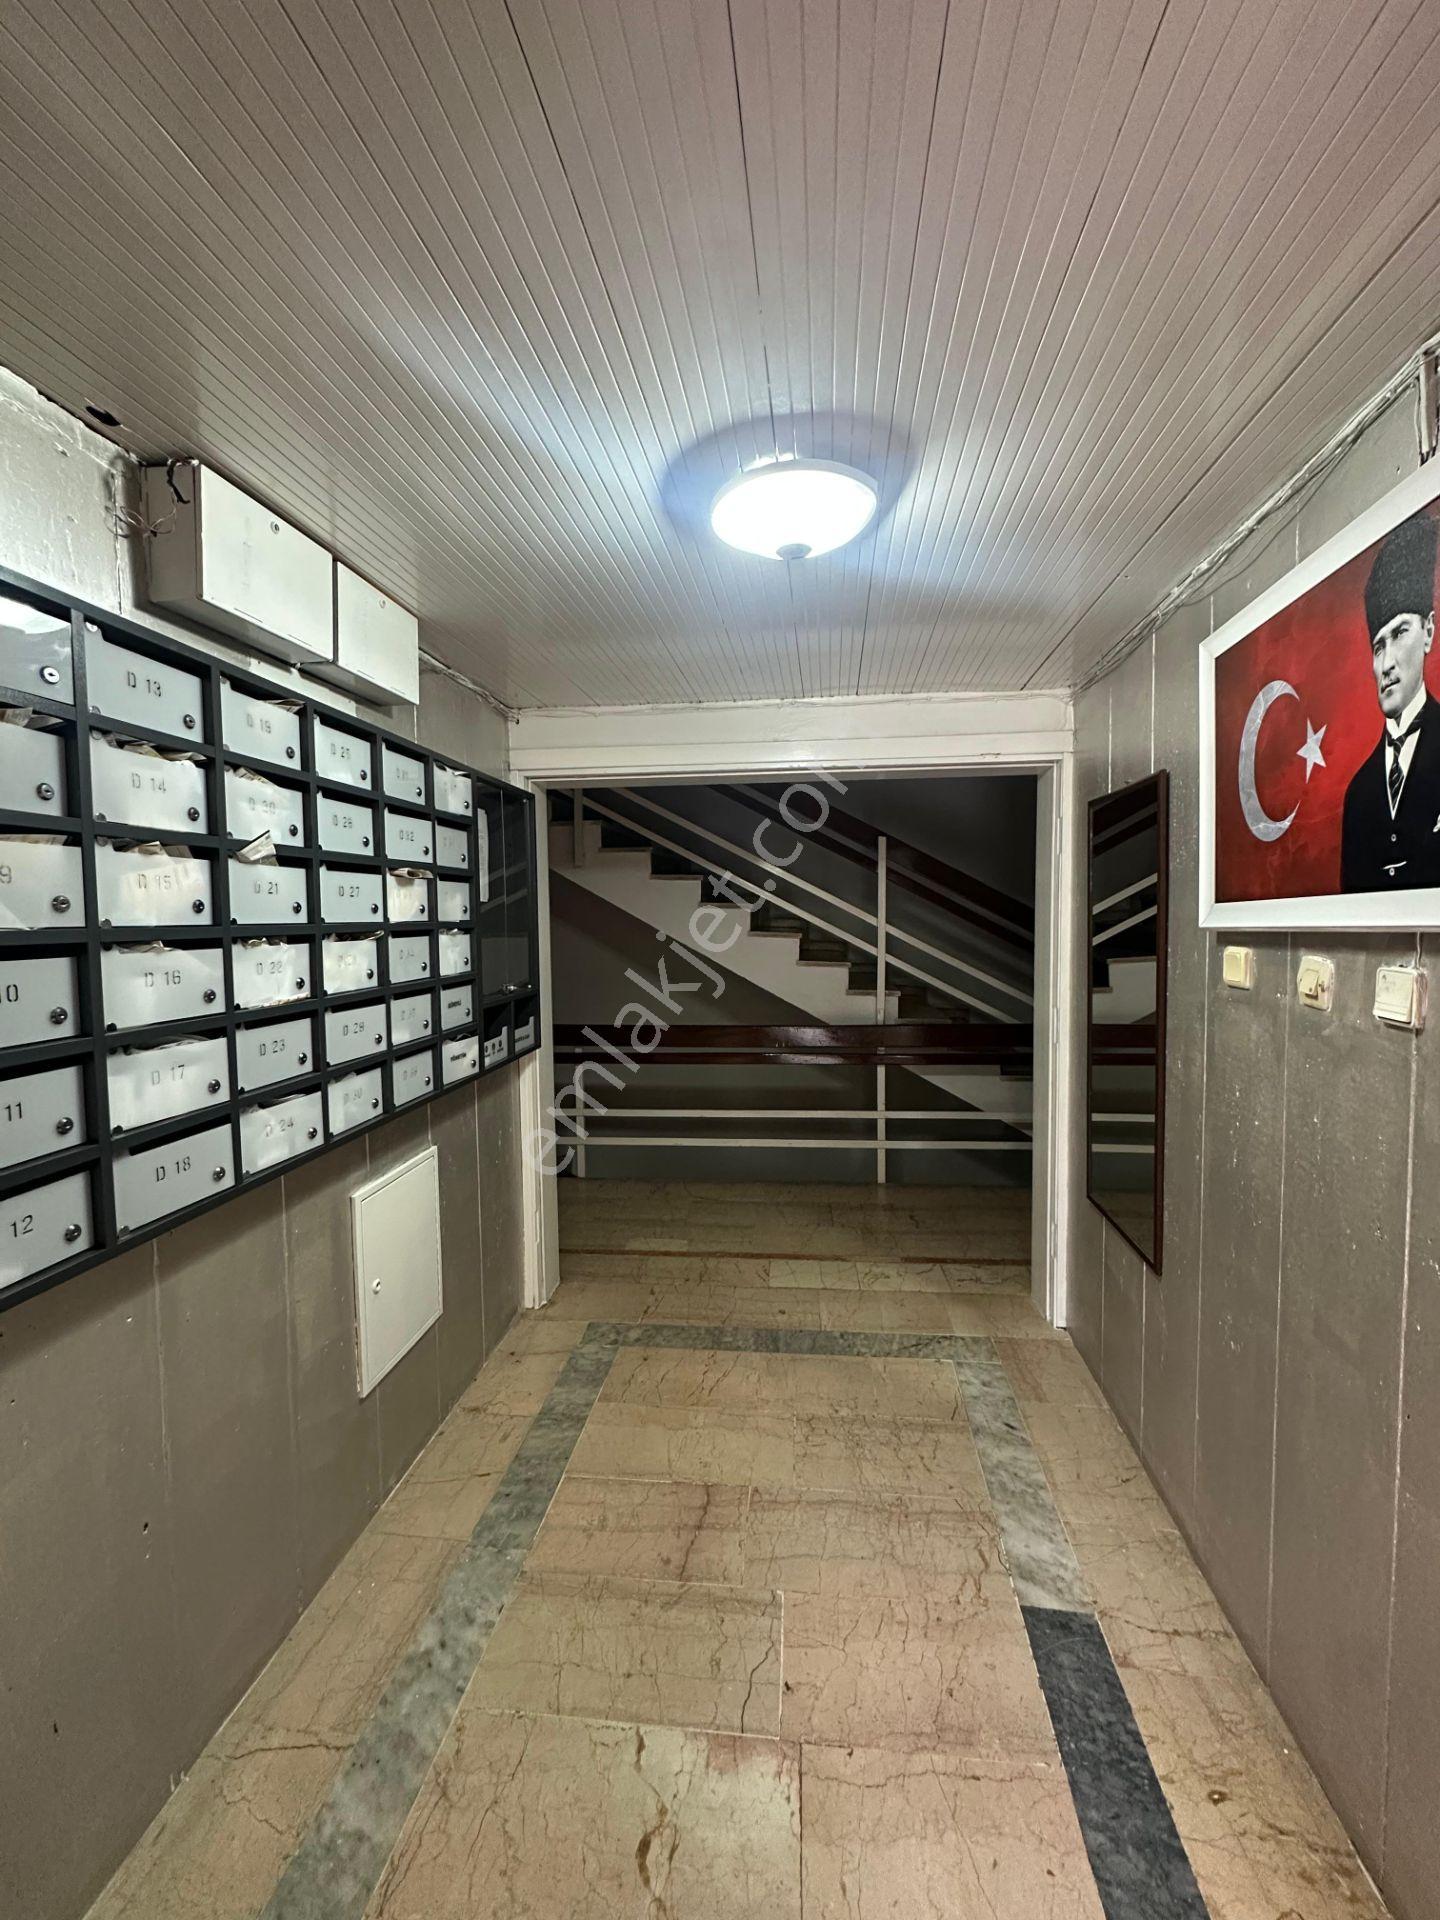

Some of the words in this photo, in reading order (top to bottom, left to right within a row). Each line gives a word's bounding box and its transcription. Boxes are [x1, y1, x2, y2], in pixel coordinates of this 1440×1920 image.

[127, 671, 137, 689] D
[146, 678, 163, 698] 13
[131, 772, 141, 790] D
[150, 777, 167, 795] 14
[137, 873, 147, 890] D
[155, 874, 173, 892] 15
[267, 881, 279, 895] 21
[349, 886, 360, 898] 27
[144, 971, 155, 988] D
[164, 969, 182, 986] 16
[259, 1042, 267, 1057] D
[273, 1038, 286, 1055] 23
[151, 1069, 161, 1087] D
[170, 1063, 186, 1082] 17
[4, 1101, 23, 1123] 11
[155, 1164, 166, 1183] D
[175, 1156, 192, 1175] 18
[10, 1213, 34, 1239] 12
